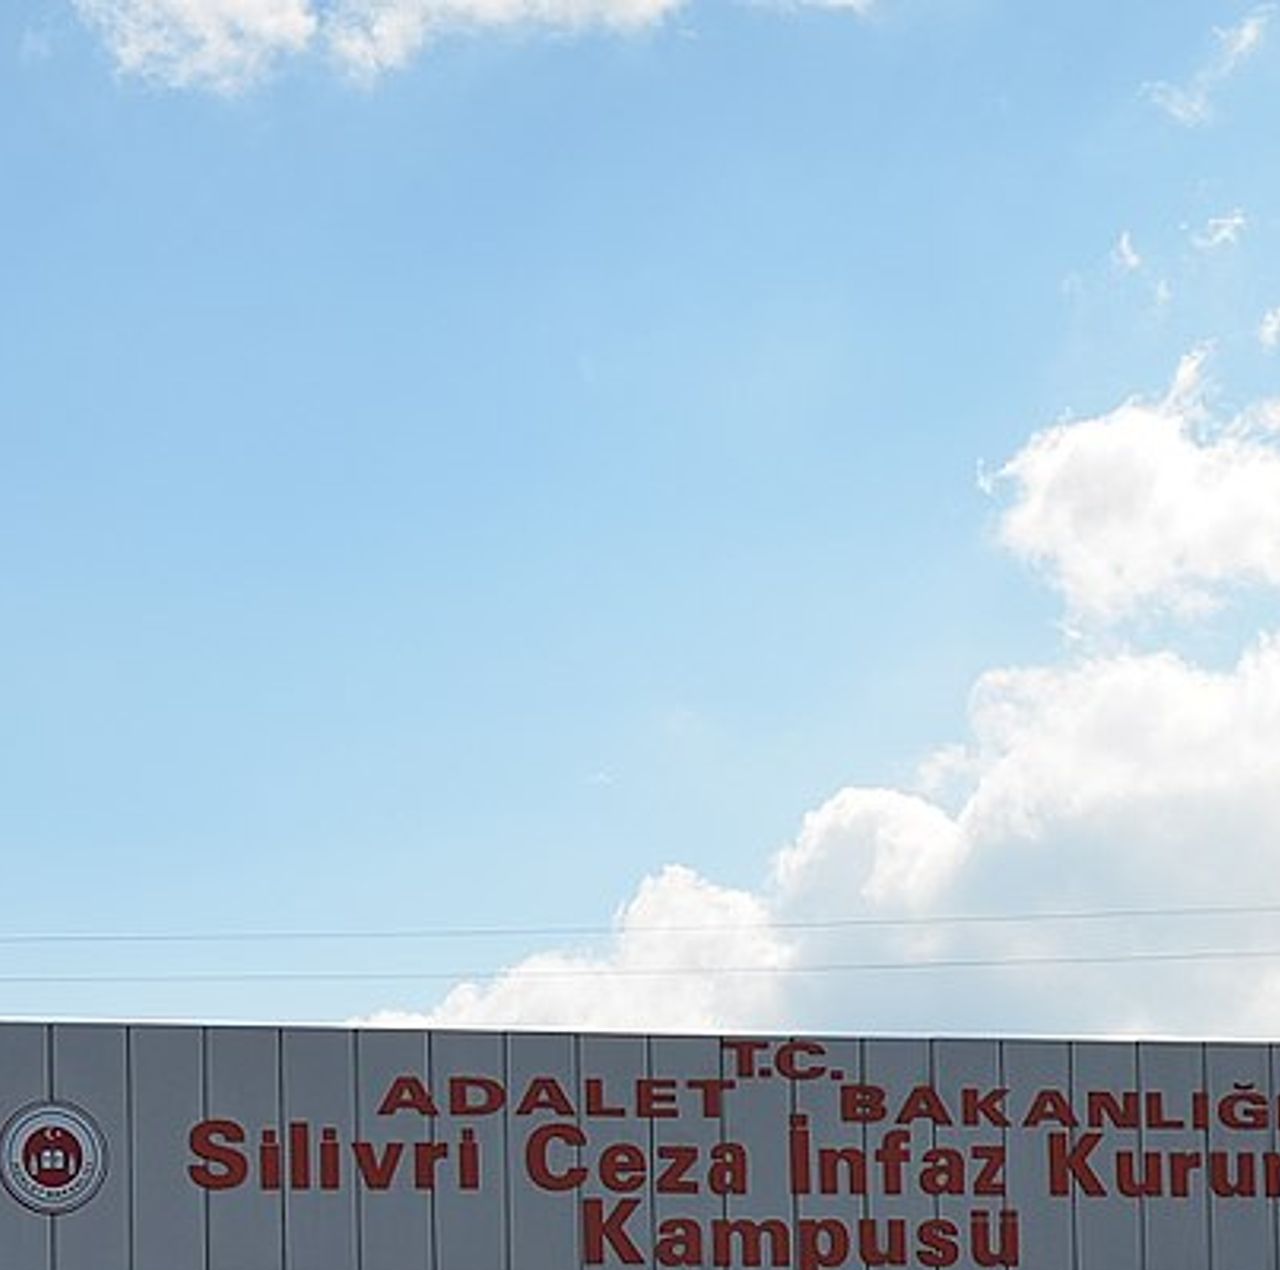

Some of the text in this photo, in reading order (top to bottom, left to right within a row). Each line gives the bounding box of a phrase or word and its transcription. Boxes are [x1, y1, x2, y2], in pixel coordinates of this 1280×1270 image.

[723, 1041, 845, 1081] T.C.
[378, 1076, 737, 1119] ADALET
[187, 1119, 481, 1192] Silivri
[526, 1122, 749, 1196] Ceza
[790, 1113, 1007, 1196] İnfaz
